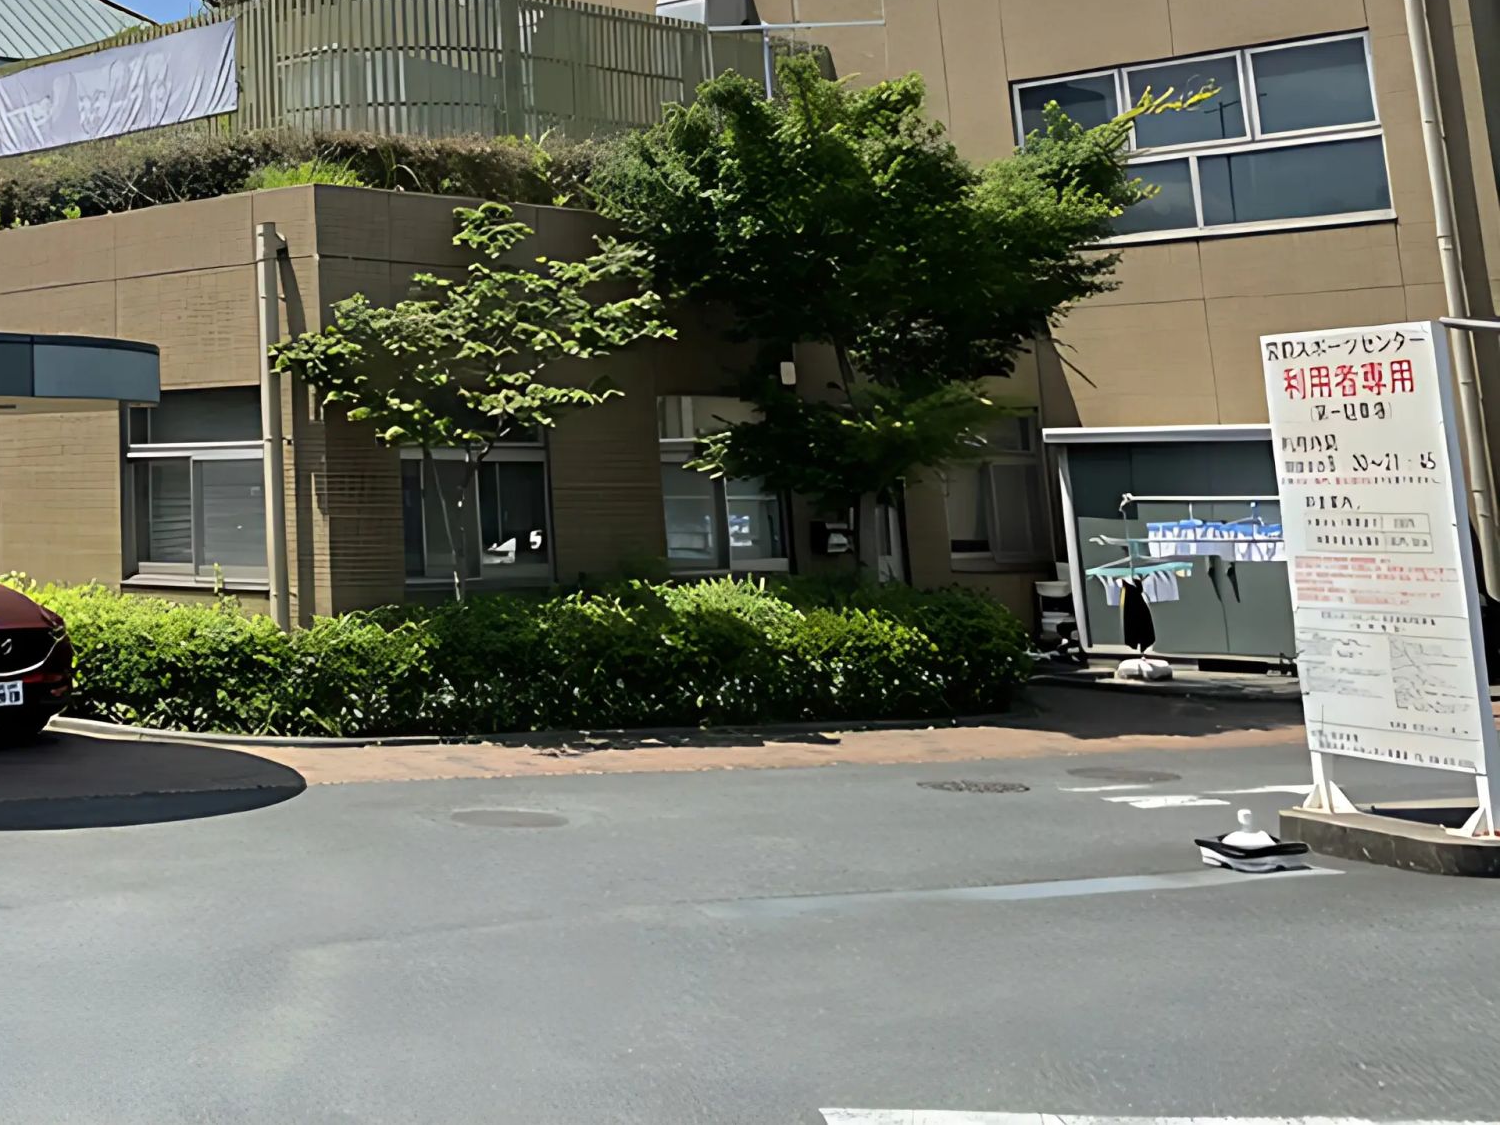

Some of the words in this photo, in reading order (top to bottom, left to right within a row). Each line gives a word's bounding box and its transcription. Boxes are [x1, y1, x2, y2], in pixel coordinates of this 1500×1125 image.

[1283, 359, 1416, 400] 利用者専用
